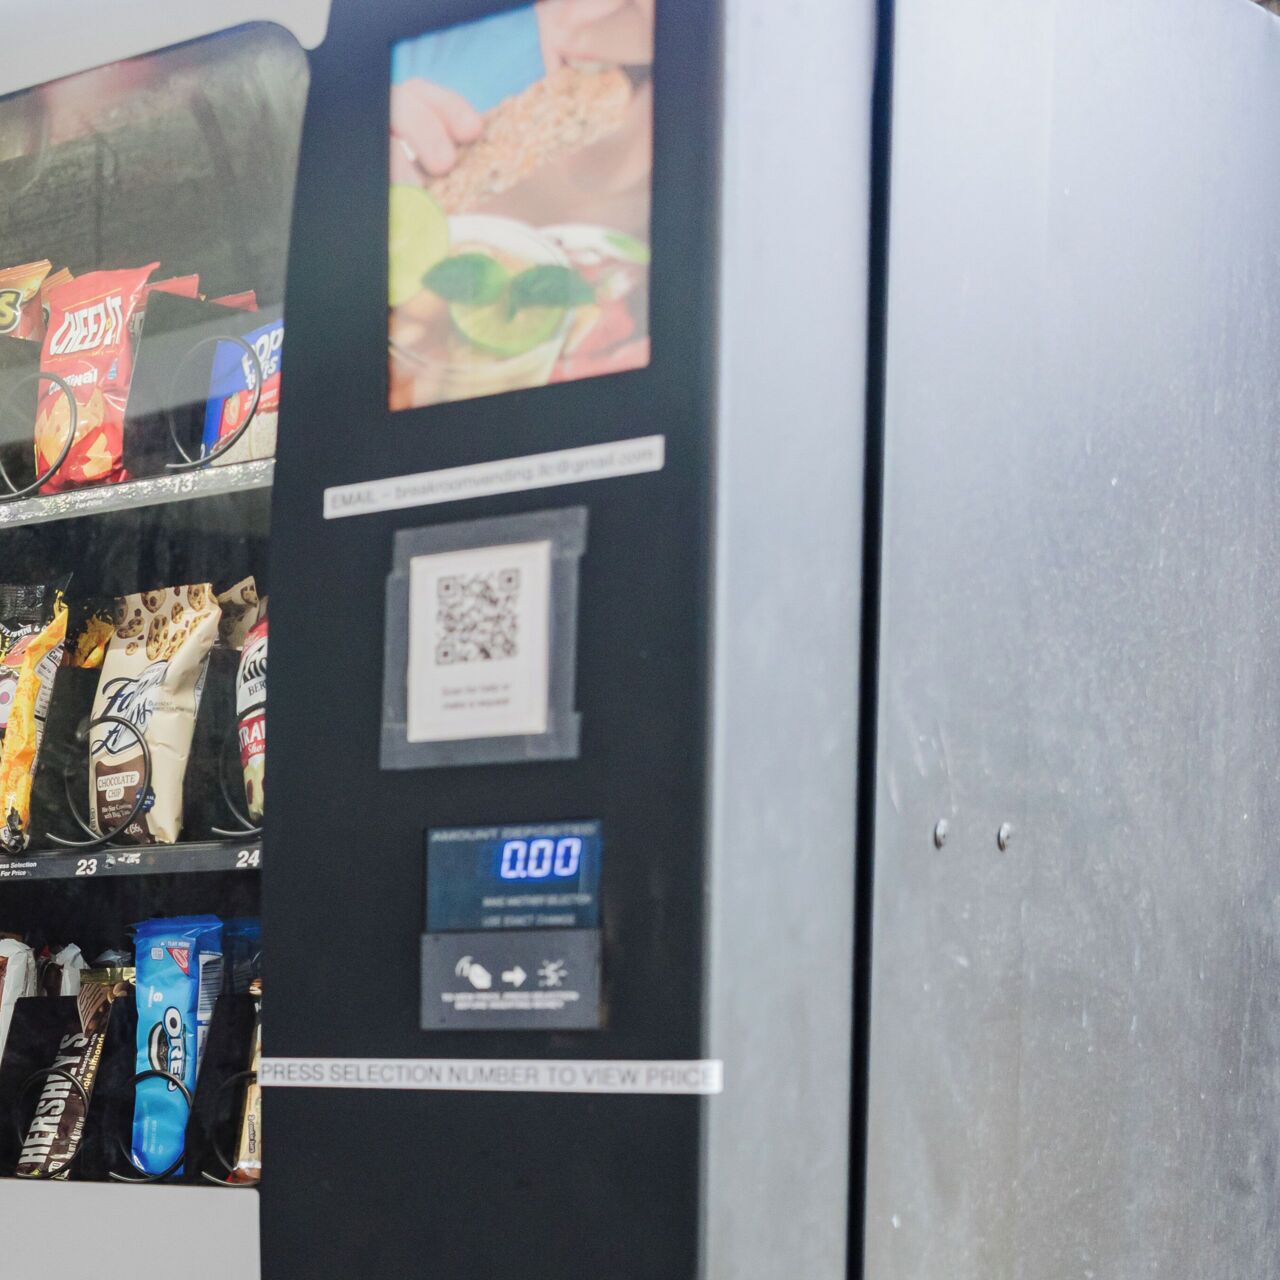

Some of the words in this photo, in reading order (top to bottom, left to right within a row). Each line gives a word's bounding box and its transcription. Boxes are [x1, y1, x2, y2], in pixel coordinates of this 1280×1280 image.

[98, 773, 137, 789] CHOCOLATE
[107, 788, 122, 799] CHIP
[10, 860, 38, 870] Selection
[75, 858, 98, 876] 23
[236, 849, 261, 869] 24
[500, 838, 582, 880] 0.00
[0, 870, 11, 878] For
[11, 869, 28, 877] Price
[260, 1062, 325, 1082] PRESS
[329, 1063, 441, 1085] SELECTION
[448, 1065, 538, 1087] NUMBER
[548, 1066, 577, 1087] TO
[582, 1066, 637, 1086] VIEW
[644, 1066, 713, 1087] PRICE
